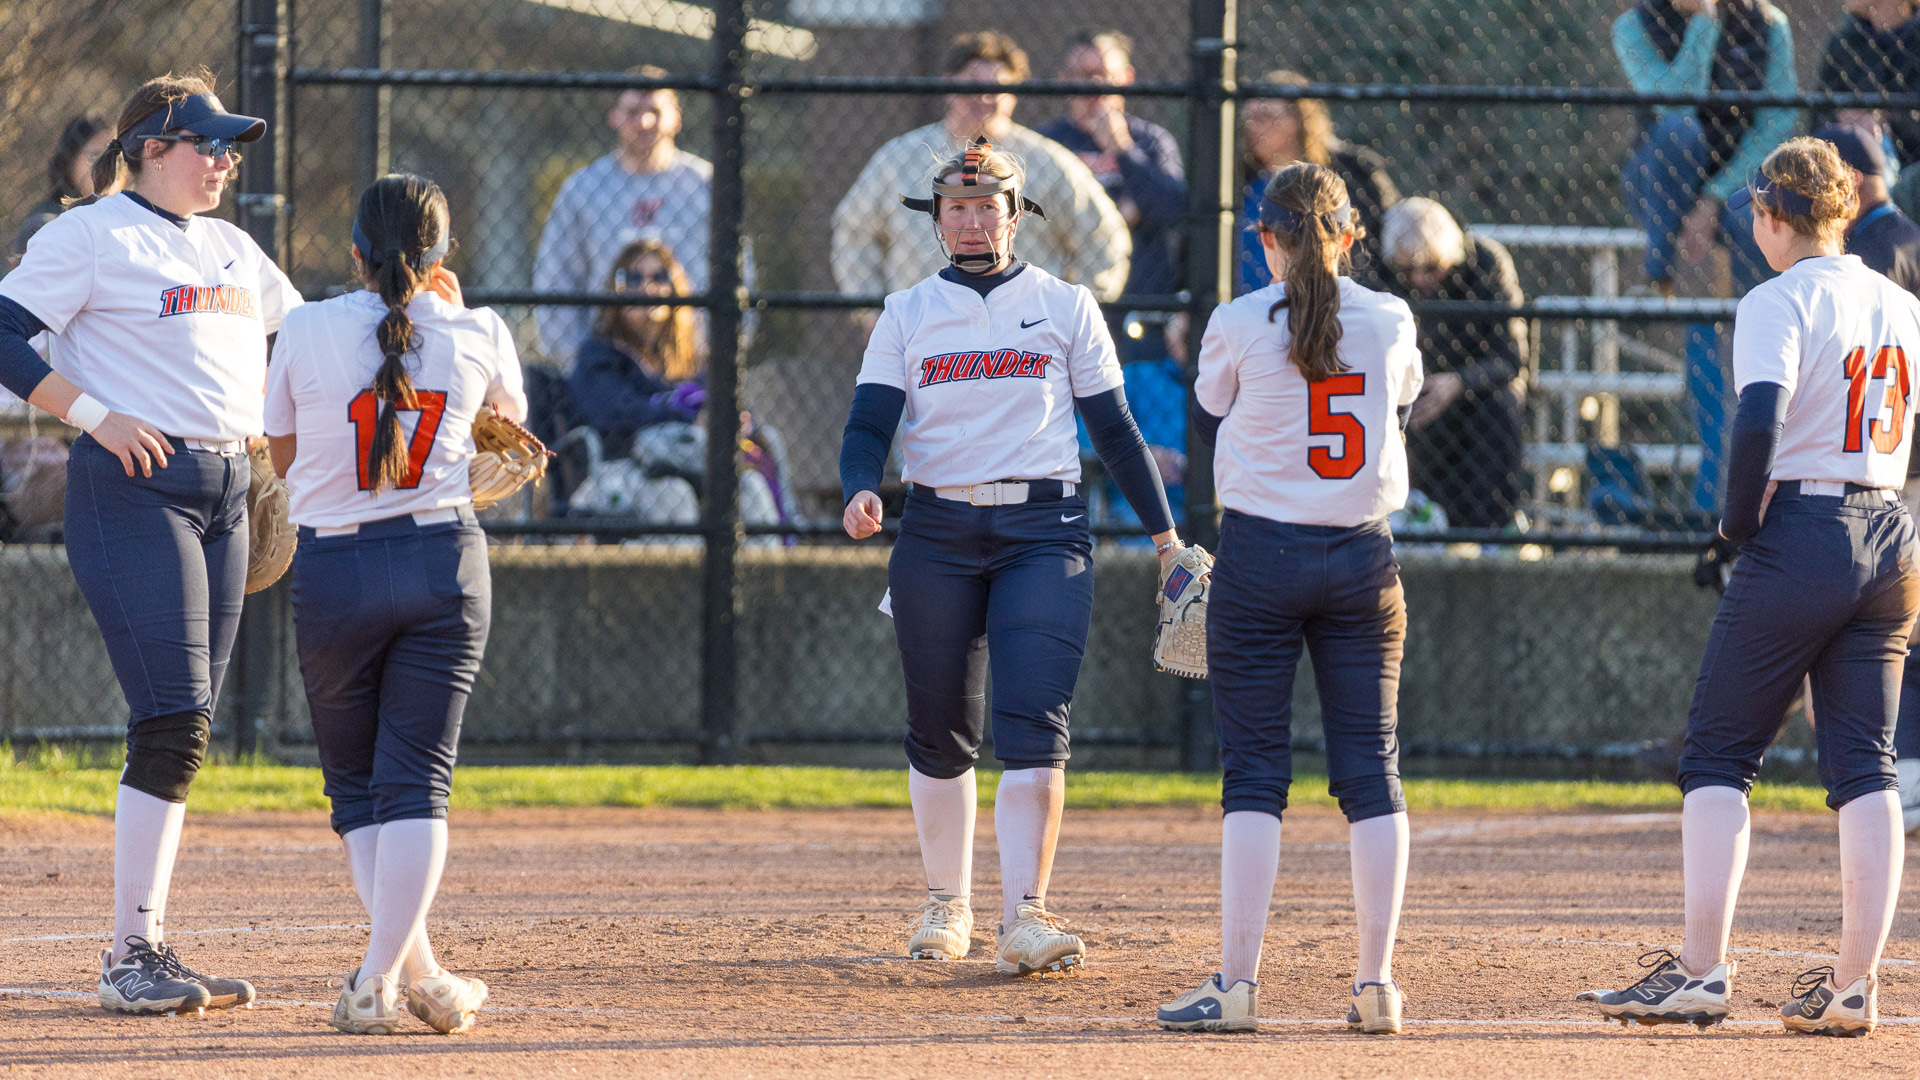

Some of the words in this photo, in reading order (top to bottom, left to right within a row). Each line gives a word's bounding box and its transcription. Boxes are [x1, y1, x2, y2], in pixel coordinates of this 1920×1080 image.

[918, 348, 1052, 389] THUNDER
[1842, 345, 1910, 454] 13
[347, 388, 448, 491] 17
[1307, 372, 1366, 479] 5
